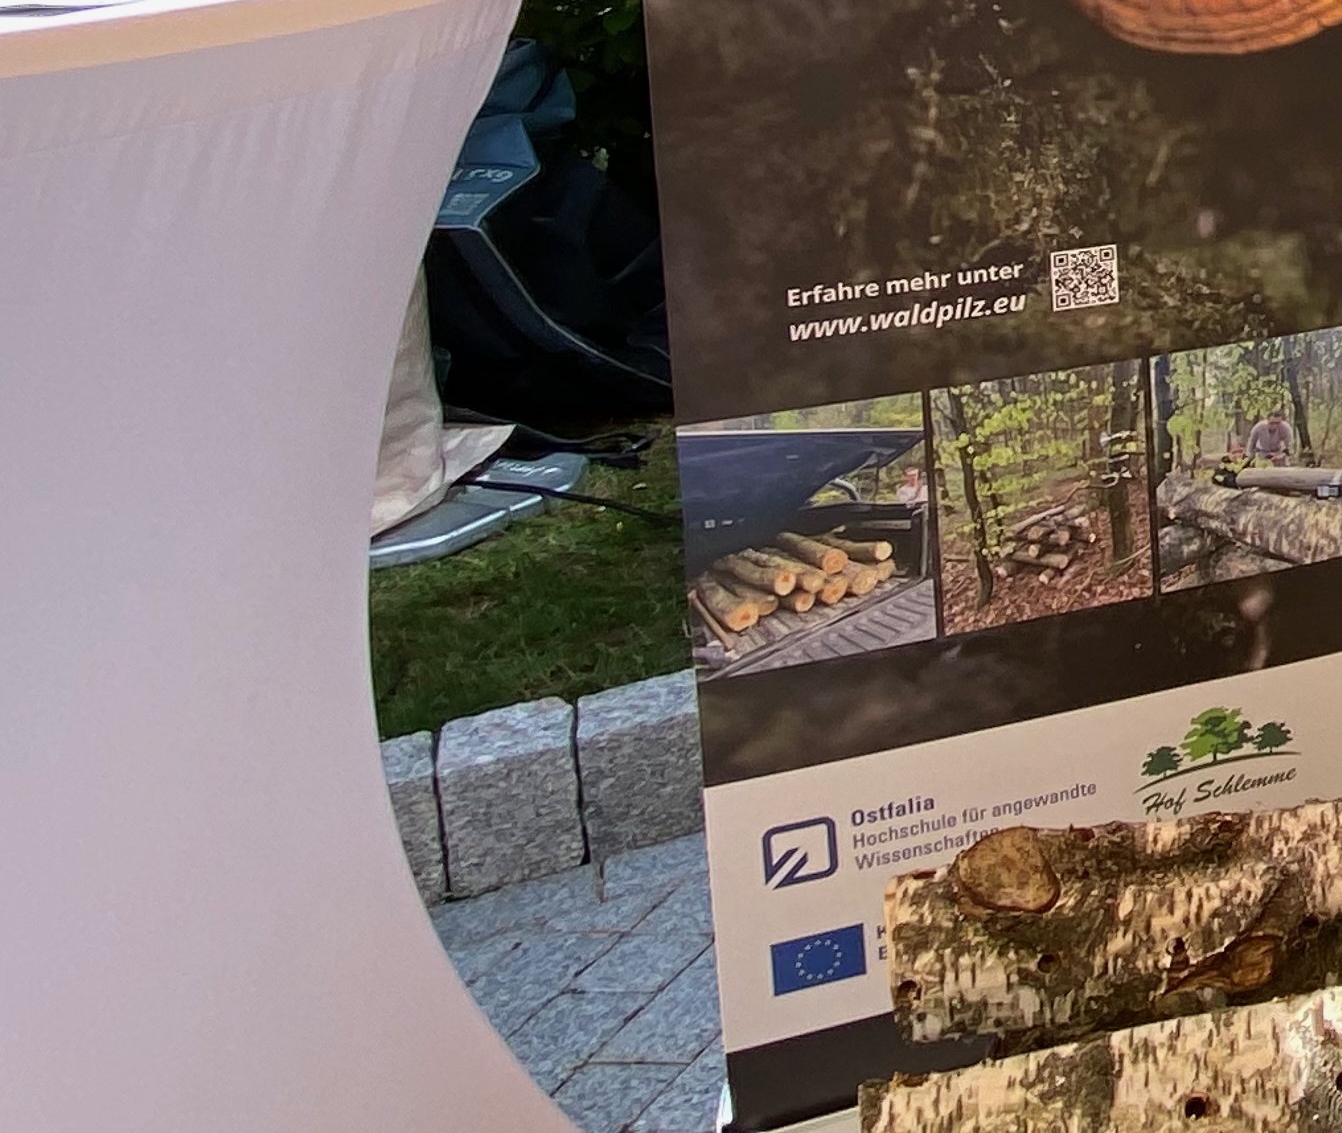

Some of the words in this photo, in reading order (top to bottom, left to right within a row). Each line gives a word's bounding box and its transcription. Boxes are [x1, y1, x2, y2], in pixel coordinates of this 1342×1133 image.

[787, 282, 880, 308] Erfahre
[886, 271, 952, 295] mehr
[957, 261, 1025, 286] unter
[788, 294, 1027, 342] www.waldpilz.eu
[850, 796, 935, 827] Ostfalia
[1142, 792, 1186, 816] Hof
[1193, 767, 1298, 803] Schlemme
[852, 813, 957, 850] Hochschule
[961, 807, 987, 824] für
[991, 782, 1097, 819] angewandte
